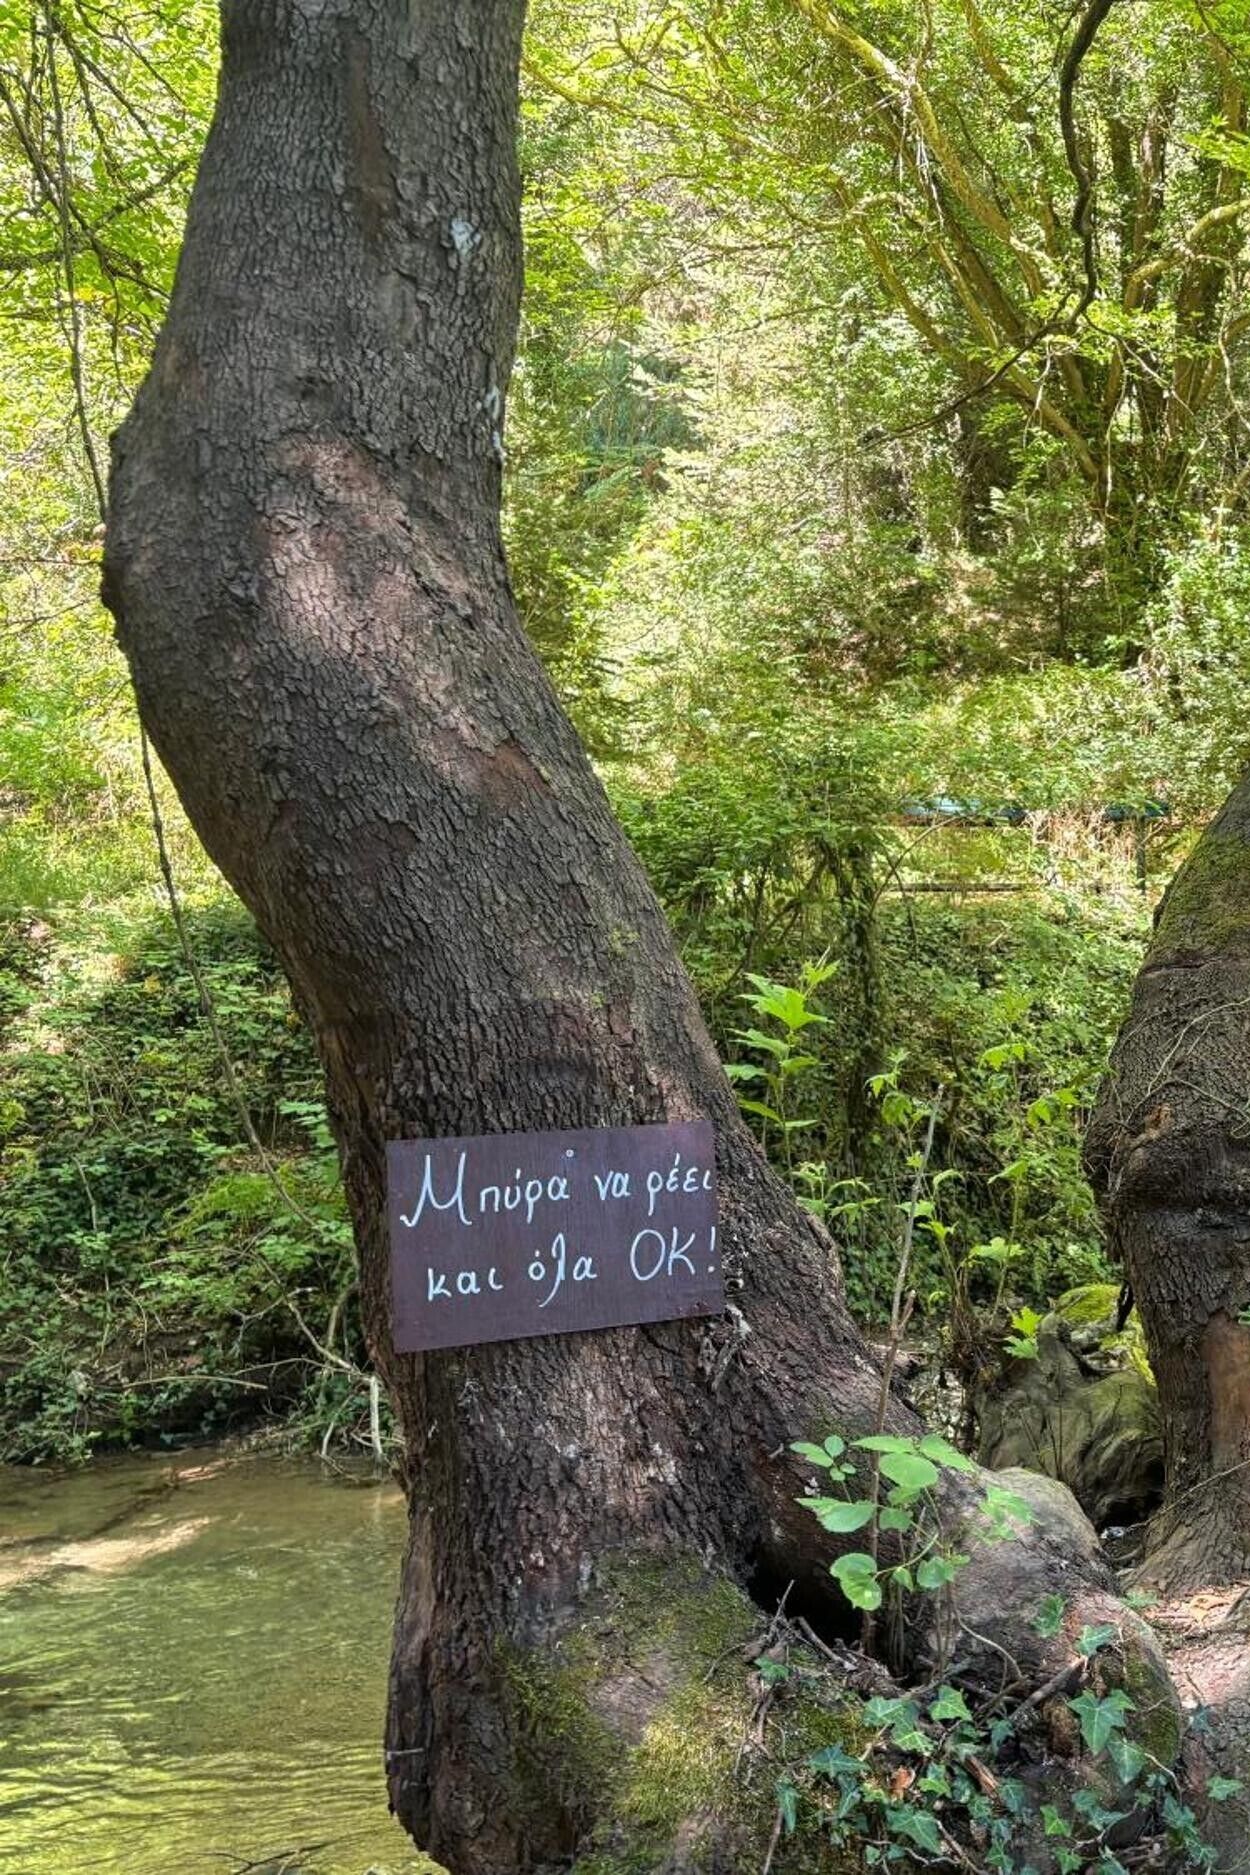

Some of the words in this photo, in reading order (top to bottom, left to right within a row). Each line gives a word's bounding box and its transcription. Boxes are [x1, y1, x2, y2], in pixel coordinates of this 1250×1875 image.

[400, 1152, 570, 1227] Μπύρα
[594, 1171, 631, 1201] να
[646, 1153, 713, 1217] ρέει
[427, 1267, 504, 1302] και
[527, 1232, 598, 1308] όλα
